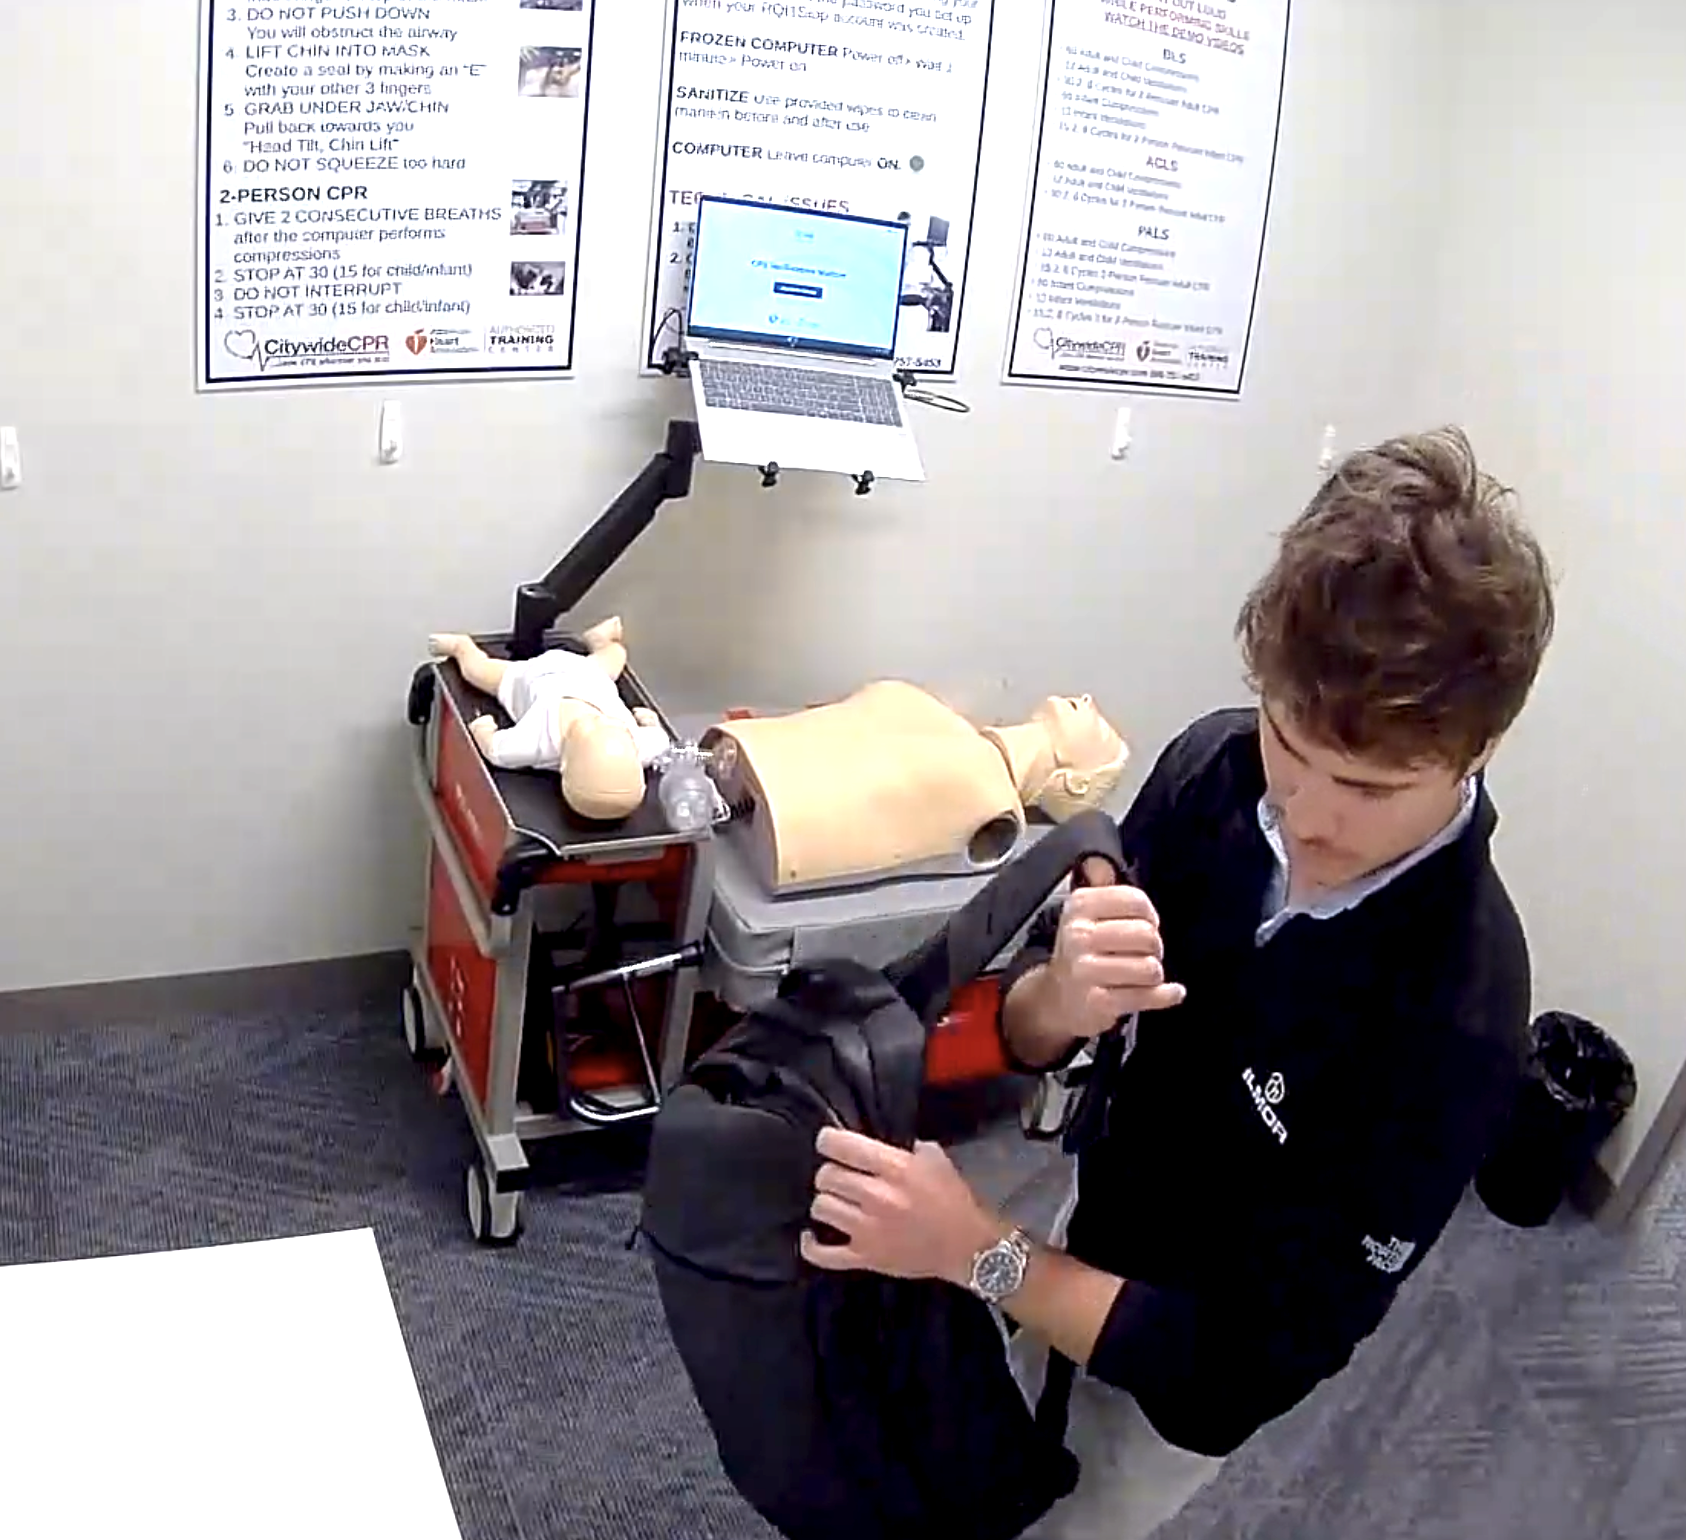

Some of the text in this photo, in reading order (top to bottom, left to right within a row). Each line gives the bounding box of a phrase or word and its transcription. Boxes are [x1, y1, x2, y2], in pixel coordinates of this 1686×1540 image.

[247, 7, 274, 21] DO
[279, 7, 316, 20] NOT
[321, 6, 370, 19] PUSH
[375, 6, 430, 19] DOWN
[726, 2, 755, 13] your
[834, 13, 884, 29] account
[888, 20, 913, 33] was
[909, 7, 930, 18] you
[956, 14, 972, 26] up
[247, 25, 457, 42] You will obstruct the airway
[1172, 26, 1204, 44] DEMO
[246, 44, 282, 59] LIFT
[287, 44, 330, 58] CHIN
[336, 44, 376, 57] INTO
[382, 44, 430, 57] MASK
[679, 30, 746, 48] FROZEN
[751, 37, 838, 57] COMPUTER
[843, 47, 882, 63] Power
[245, 64, 298, 78] Create
[303, 66, 313, 76] a
[318, 63, 351, 76] seal
[356, 64, 373, 79] by
[379, 63, 434, 79] making
[440, 65, 458, 76] an
[741, 54, 784, 70] Power
[789, 62, 807, 72] on
[244, 81, 432, 99] with your other 3 fingers
[676, 85, 750, 103] SANITIZE
[754, 95, 781, 105] Use
[785, 97, 843, 111] provided
[244, 101, 294, 116] GRAB
[299, 100, 361, 114] UNDER
[244, 119, 414, 136] Pull back towards you
[734, 109, 779, 123] before
[783, 114, 808, 127] and
[812, 117, 842, 130] after
[328, 136, 364, 152] Chin
[672, 141, 763, 159] COMPUTER
[767, 149, 808, 162] Leave
[812, 153, 872, 168] computer
[1146, 155, 1178, 172] ACLS
[243, 159, 269, 173] DO
[275, 157, 310, 172] NOT
[316, 156, 399, 173] SQUEEZE
[403, 157, 428, 169] too
[432, 155, 466, 169] hard
[220, 185, 368, 204] 2-PERSON CPR
[234, 210, 276, 225] GIVE
[280, 210, 291, 224] 2
[295, 207, 420, 224] CONSECUTIVE
[425, 207, 501, 221] BREATHS
[233, 225, 446, 245] after the computer performs
[1137, 225, 1170, 240] PALS
[233, 248, 341, 265] compressions
[232, 267, 280, 283] STOP
[283, 266, 305, 281] AT
[308, 265, 329, 280] 30
[333, 264, 358, 281] (15
[362, 263, 382, 278] for
[233, 286, 259, 301] DO
[264, 284, 301, 300] NOT
[305, 282, 403, 299] INTERRUPT
[233, 304, 280, 320] STOP
[283, 303, 304, 318] AT
[308, 302, 327, 317] 30
[332, 301, 357, 319] (15
[361, 300, 381, 315] for
[264, 335, 389, 356] CitywideCPR
[490, 335, 554, 345] TRAINING
